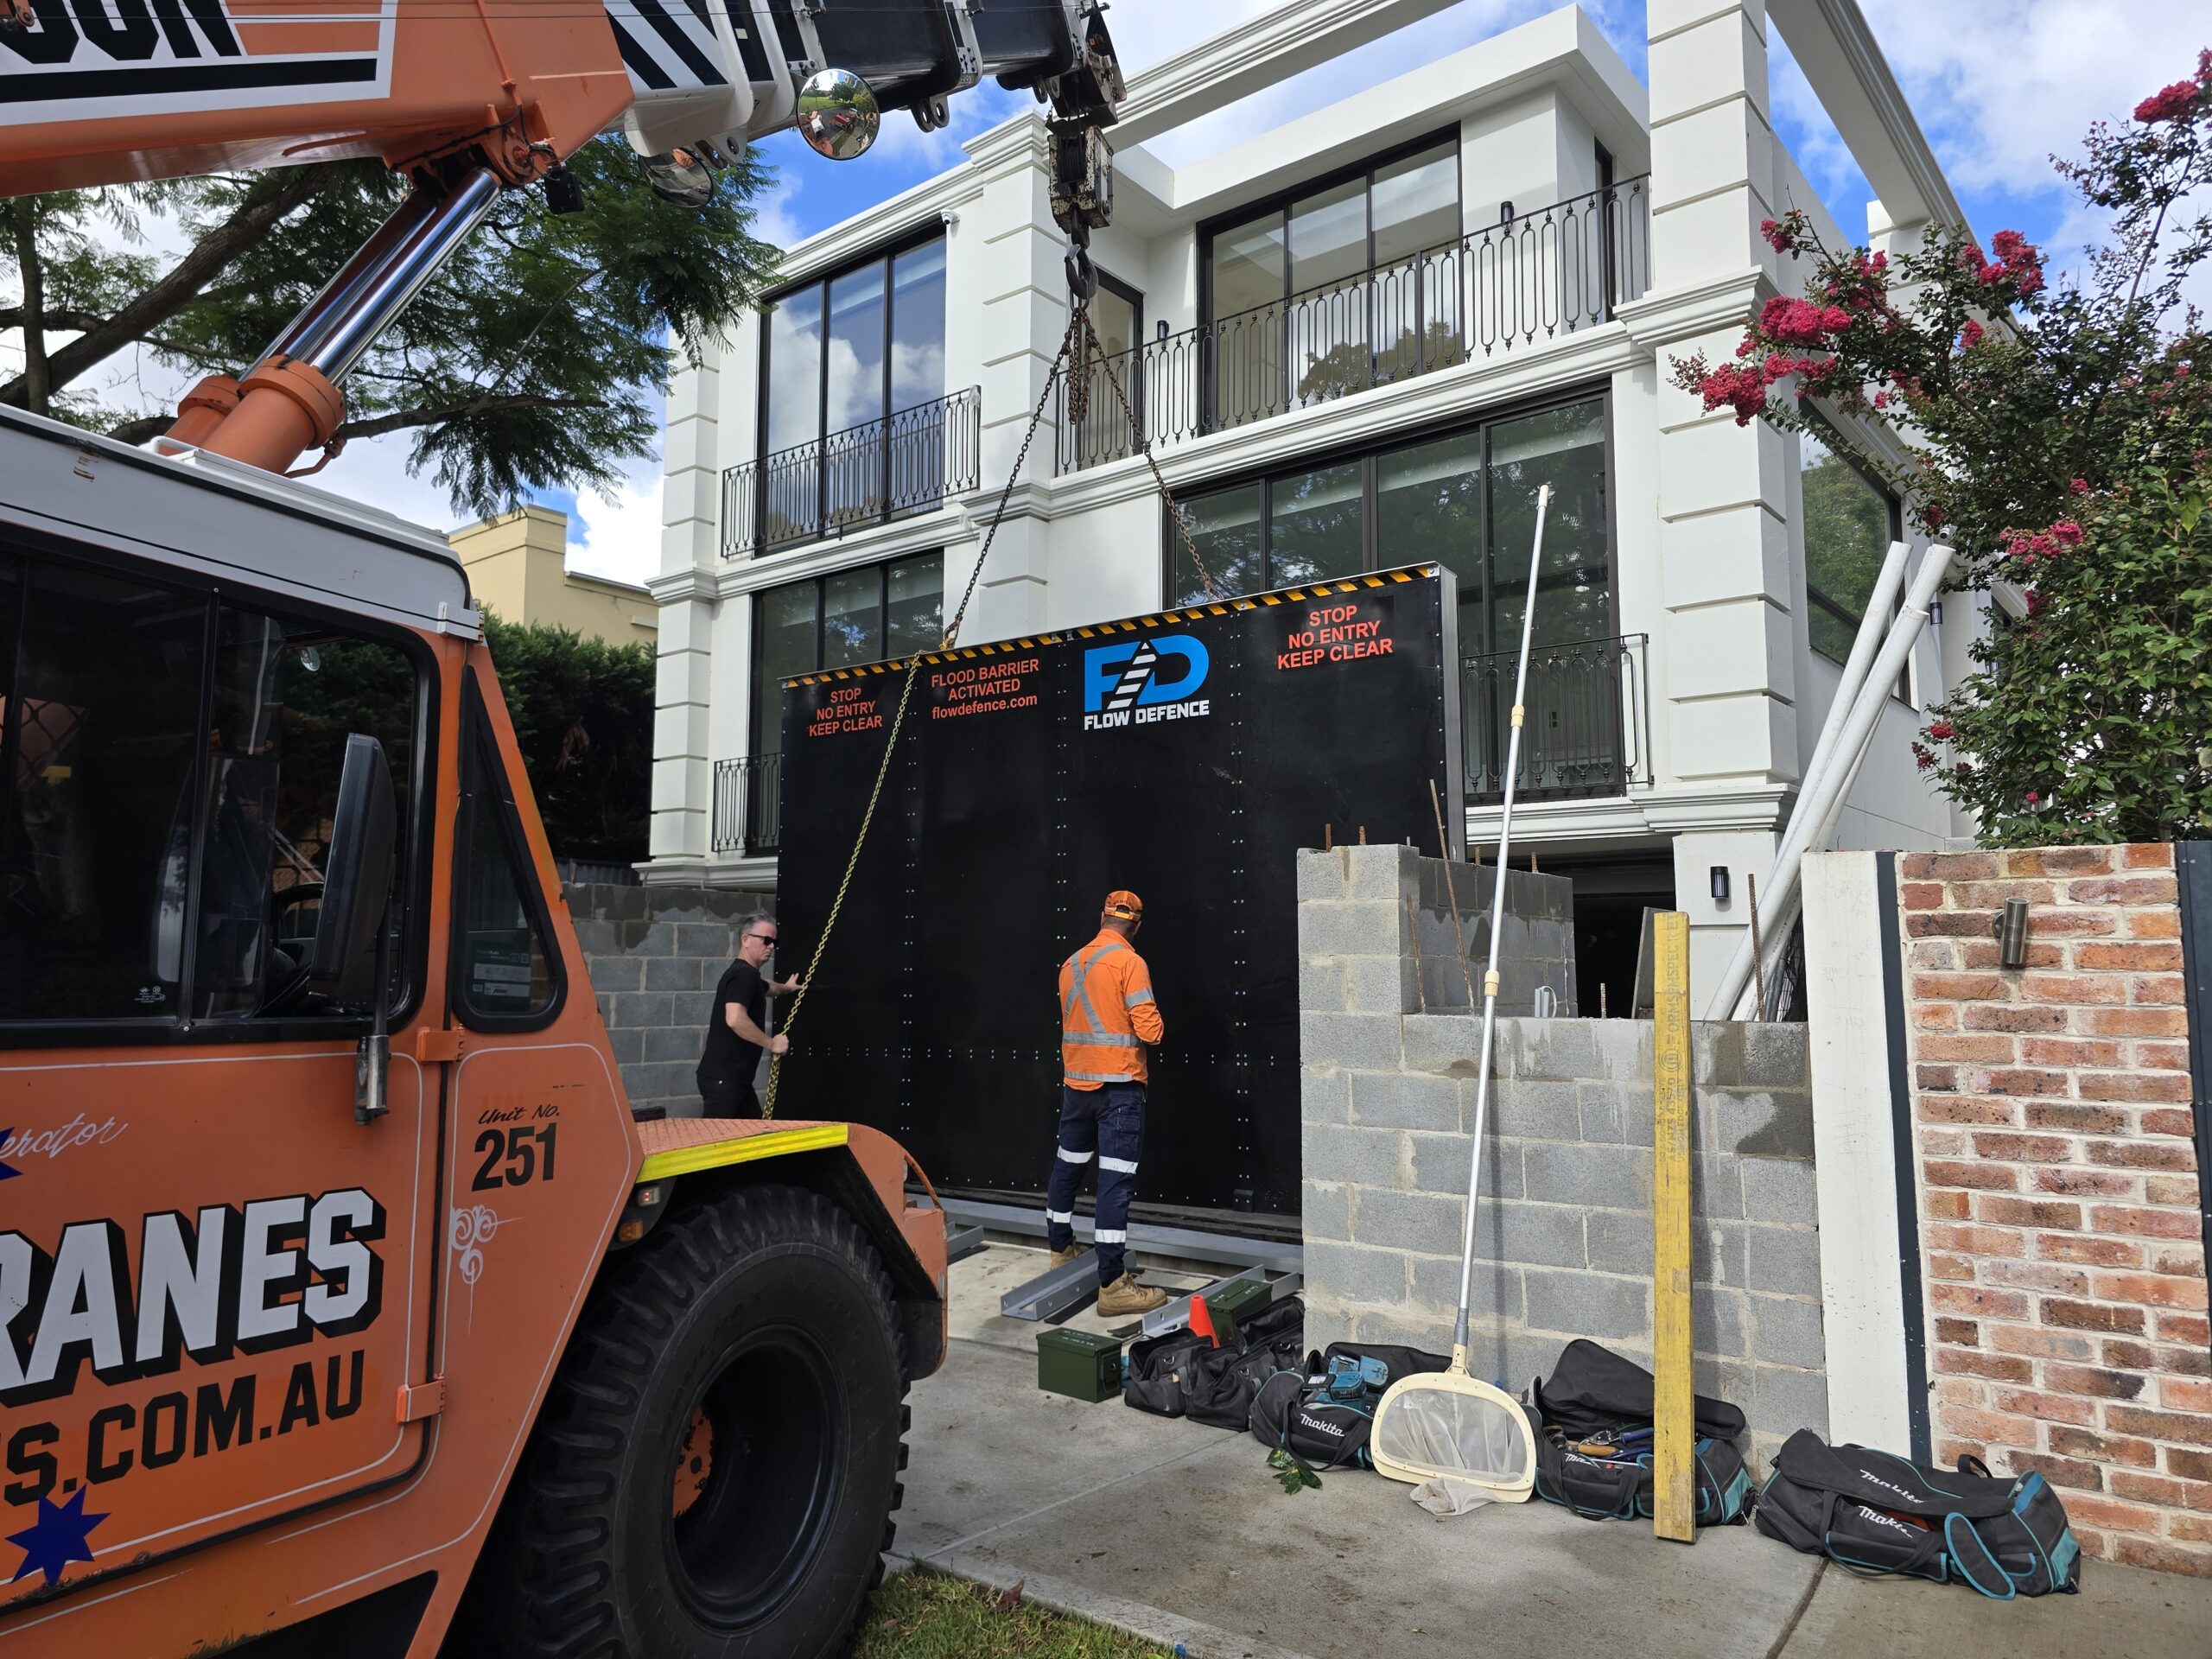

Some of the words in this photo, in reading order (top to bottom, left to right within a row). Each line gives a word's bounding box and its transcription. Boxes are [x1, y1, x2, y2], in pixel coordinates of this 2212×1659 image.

[1309, 605, 1357, 627] STOP
[1287, 631, 1315, 649] NO
[1319, 620, 1381, 645] ENTRY
[1277, 648, 1325, 670] KEEP
[1329, 638, 1394, 662] CLEAR
[931, 669, 976, 689] FLOOD
[979, 658, 1039, 681] BARRIER
[830, 687, 861, 704] STOP
[948, 678, 1020, 702] ACTIVATED
[816, 707, 834, 721] NO
[836, 700, 876, 718] ENTRY
[931, 695, 1038, 720] flowdefence.com
[1084, 710, 1130, 731] FLOW
[1135, 699, 1210, 724] DEFENCE
[808, 721, 840, 737] KEEP
[842, 715, 883, 732] CLEAR
[478, 1107, 527, 1125] Unit
[471, 1122, 557, 1192] 251
